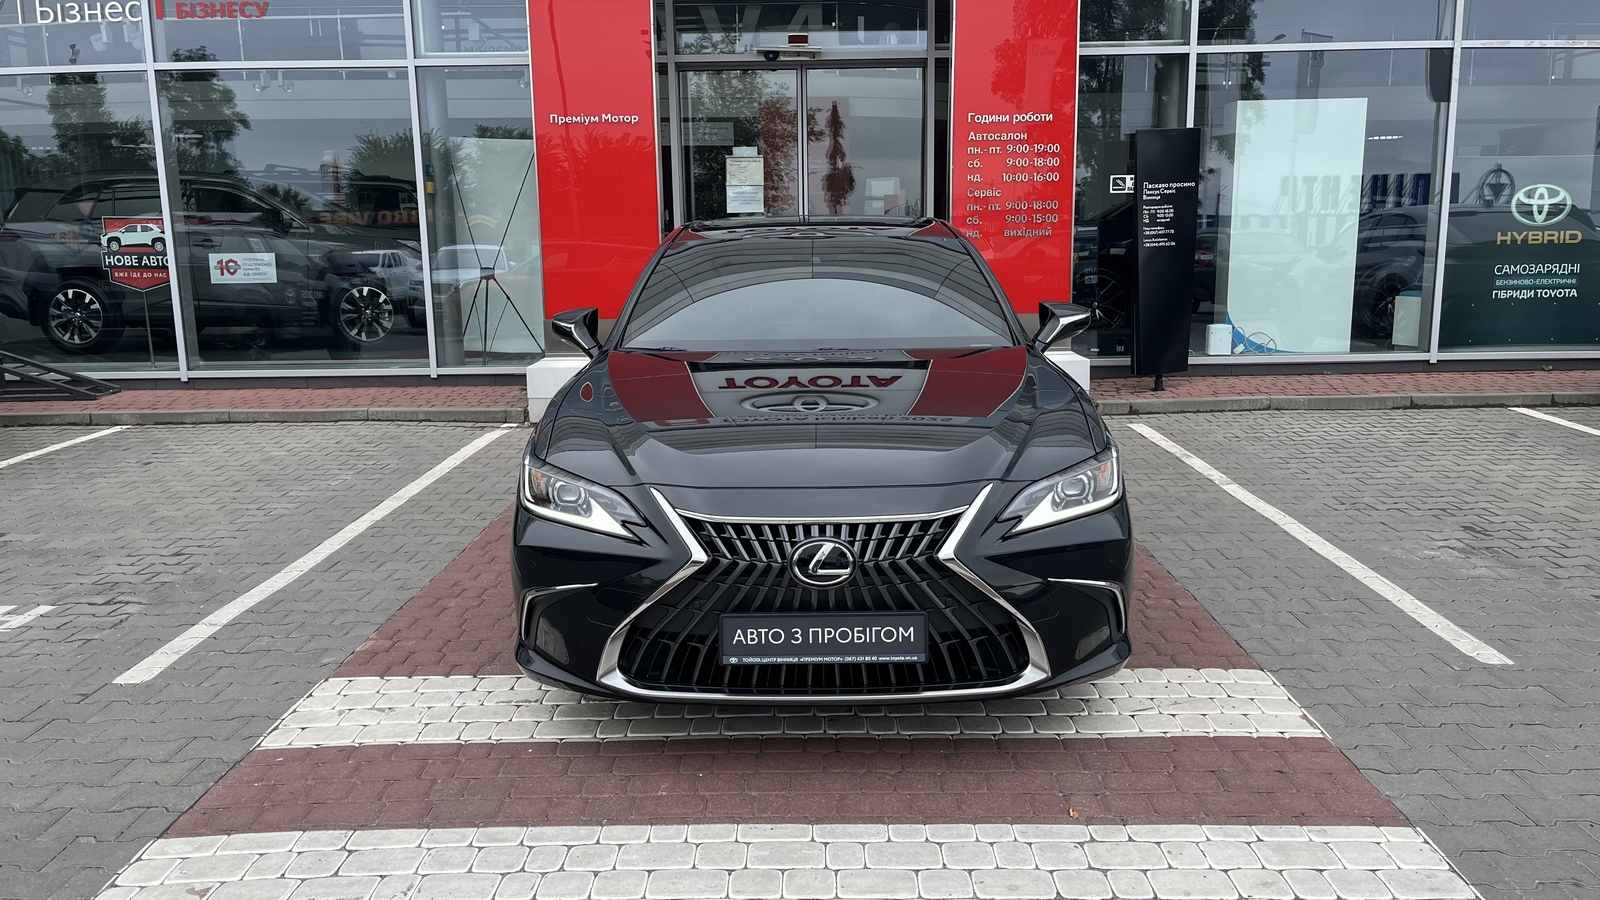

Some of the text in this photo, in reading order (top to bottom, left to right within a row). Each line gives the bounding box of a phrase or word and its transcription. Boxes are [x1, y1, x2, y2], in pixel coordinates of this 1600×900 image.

[175, 1, 268, 20] БІЗНЕСУ
[550, 113, 639, 125] Преміум Мотор
[967, 111, 1053, 125] Години роботи
[967, 131, 1028, 141] Автосалон
[1006, 143, 1060, 153] 9:00-19:00
[967, 157, 1060, 168] сб. 9:00-18:00
[967, 172, 1060, 183] нд. 10:00-16:00
[967, 187, 1002, 199] Сервіс
[1005, 200, 1059, 210] 9:00-18:00
[966, 213, 1058, 225] сб. 9:00-15:00
[966, 226, 1052, 238] нд. вихідний
[1496, 230, 1583, 245] HYBRID
[105, 255, 139, 267] НОВЕ
[1494, 263, 1580, 275] САМОЗАРЯДНІ
[1495, 278, 1577, 286] БЕНЗИНОВО-ЕЛЕКТРИЧНІ
[1492, 288, 1578, 299] ГІБРИДИ TOYOTA
[732, 626, 915, 645] АВТО З ПРОБІГОМ
